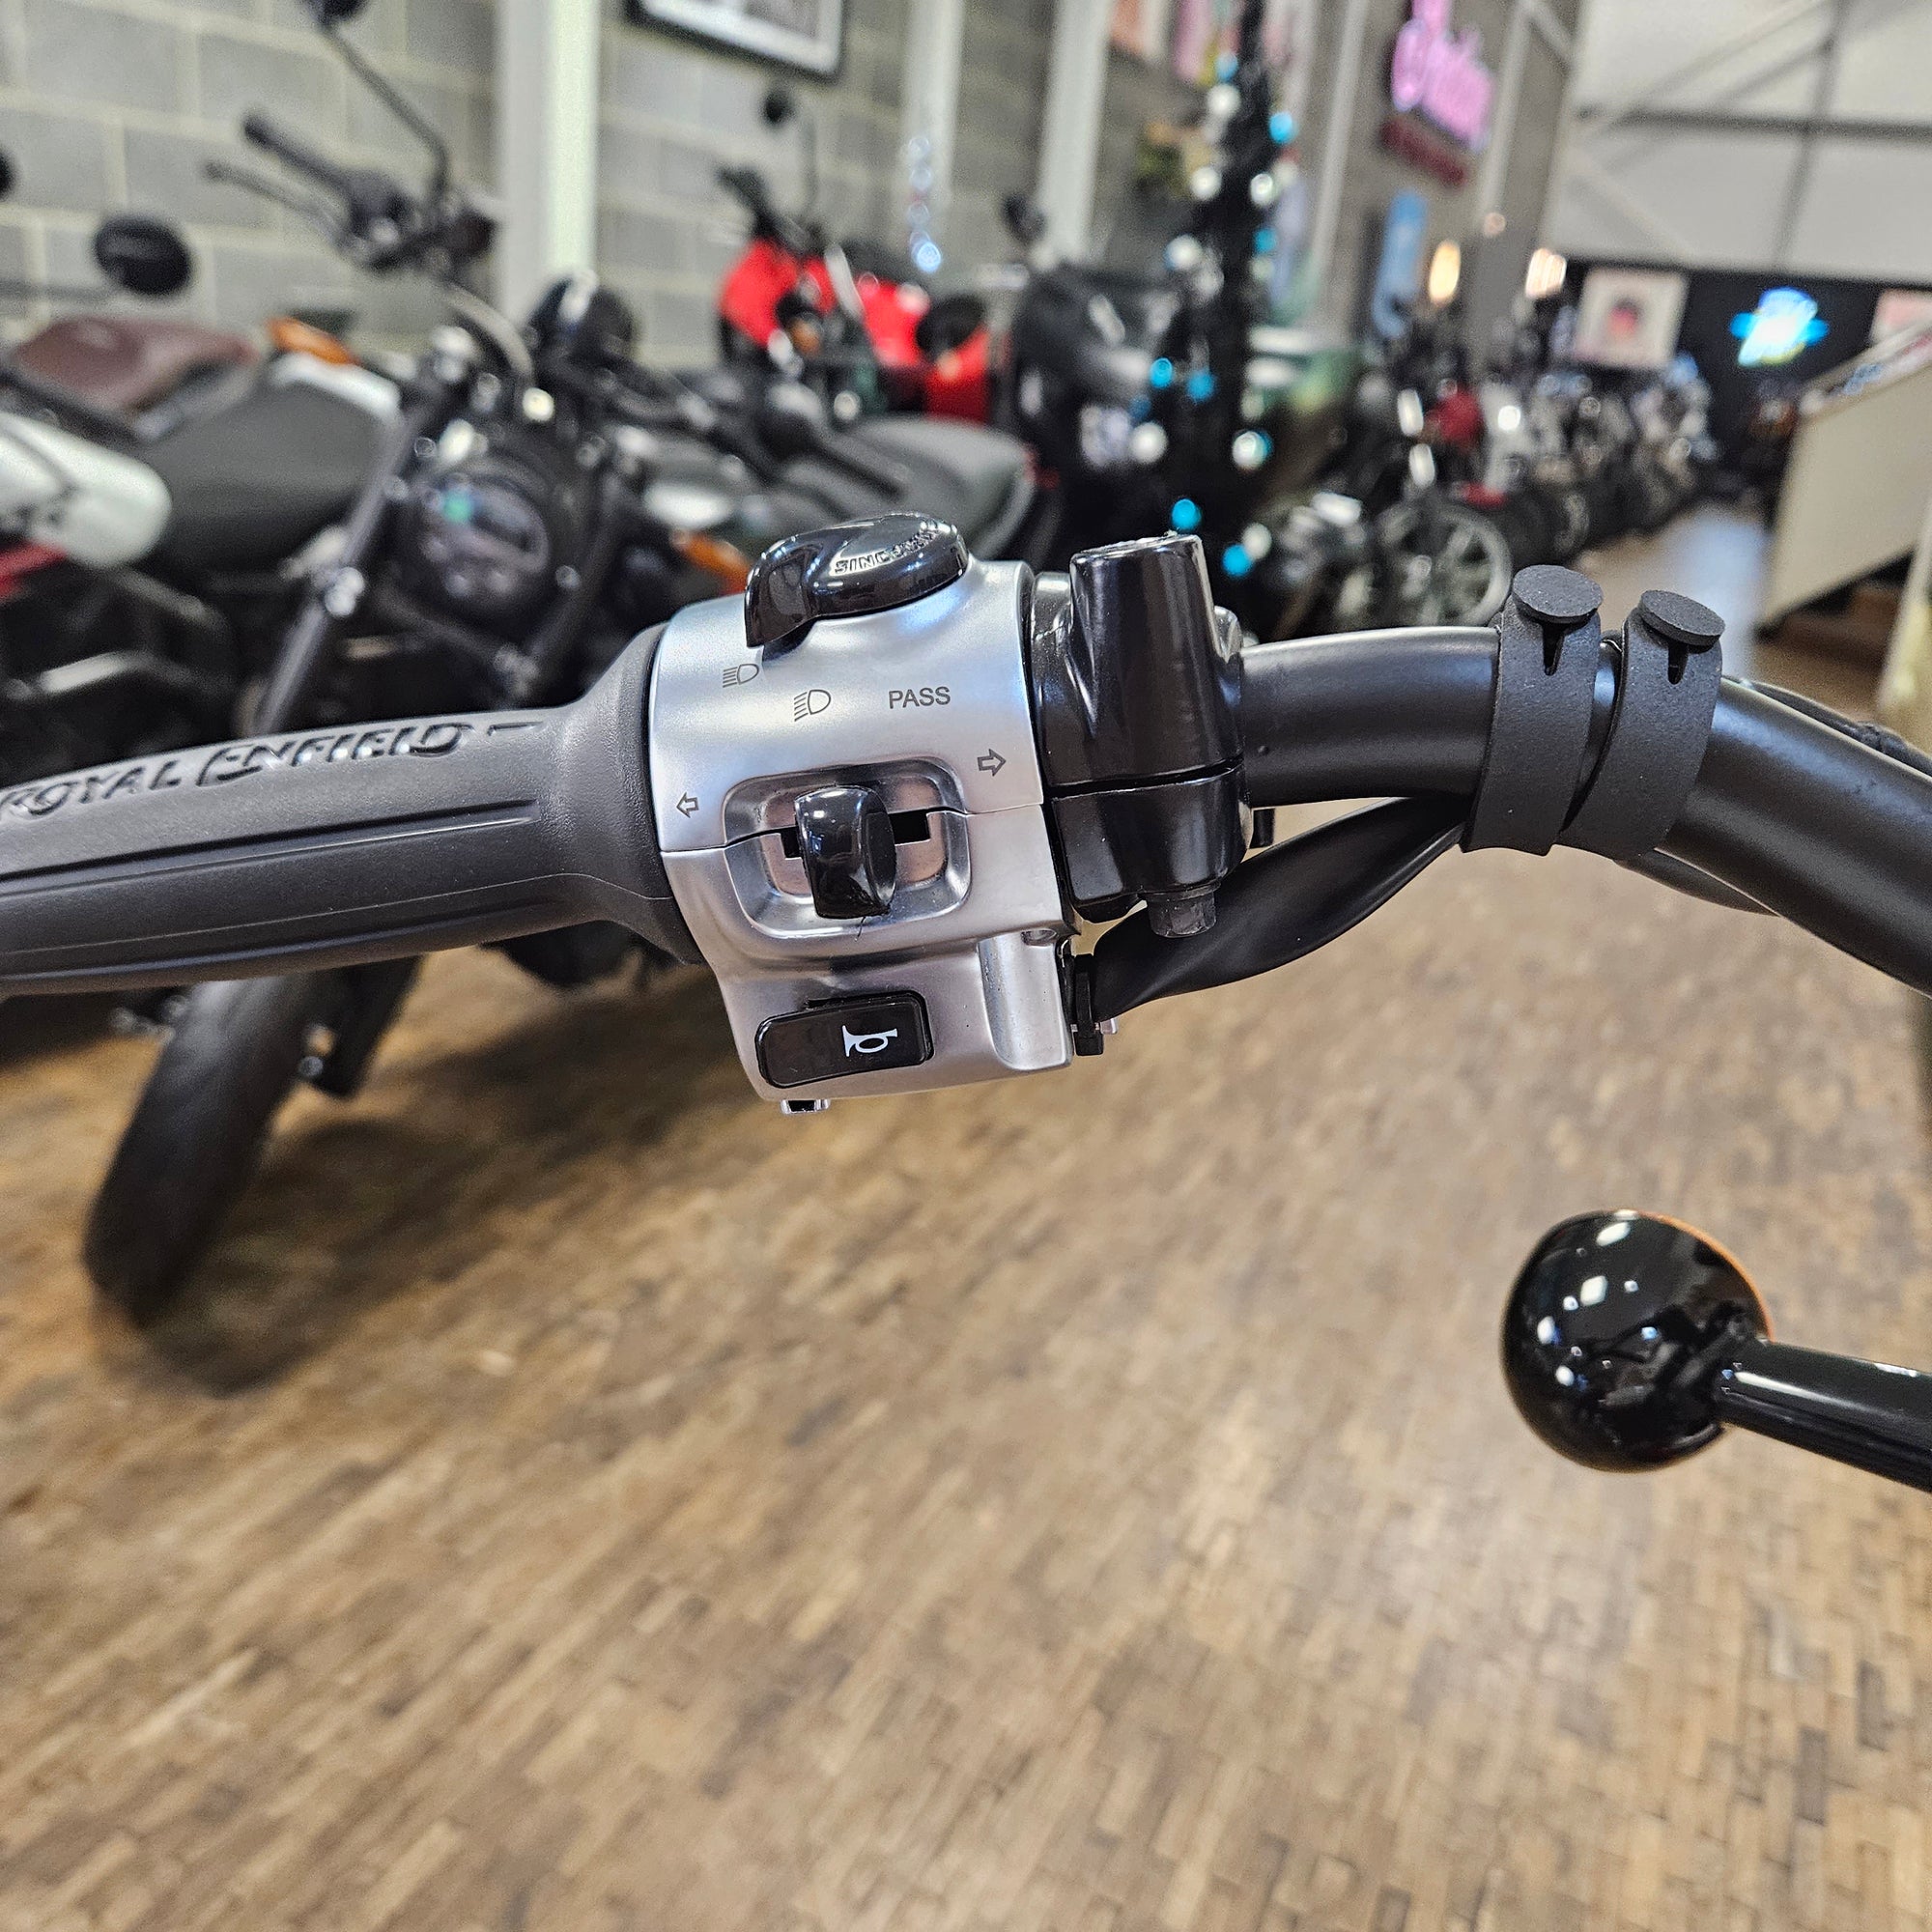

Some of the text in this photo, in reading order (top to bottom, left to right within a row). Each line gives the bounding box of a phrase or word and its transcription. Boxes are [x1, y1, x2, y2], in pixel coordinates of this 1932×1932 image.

[888, 686, 952, 710] PASS
[0, 722, 473, 818] ROYAL ENFIELD
